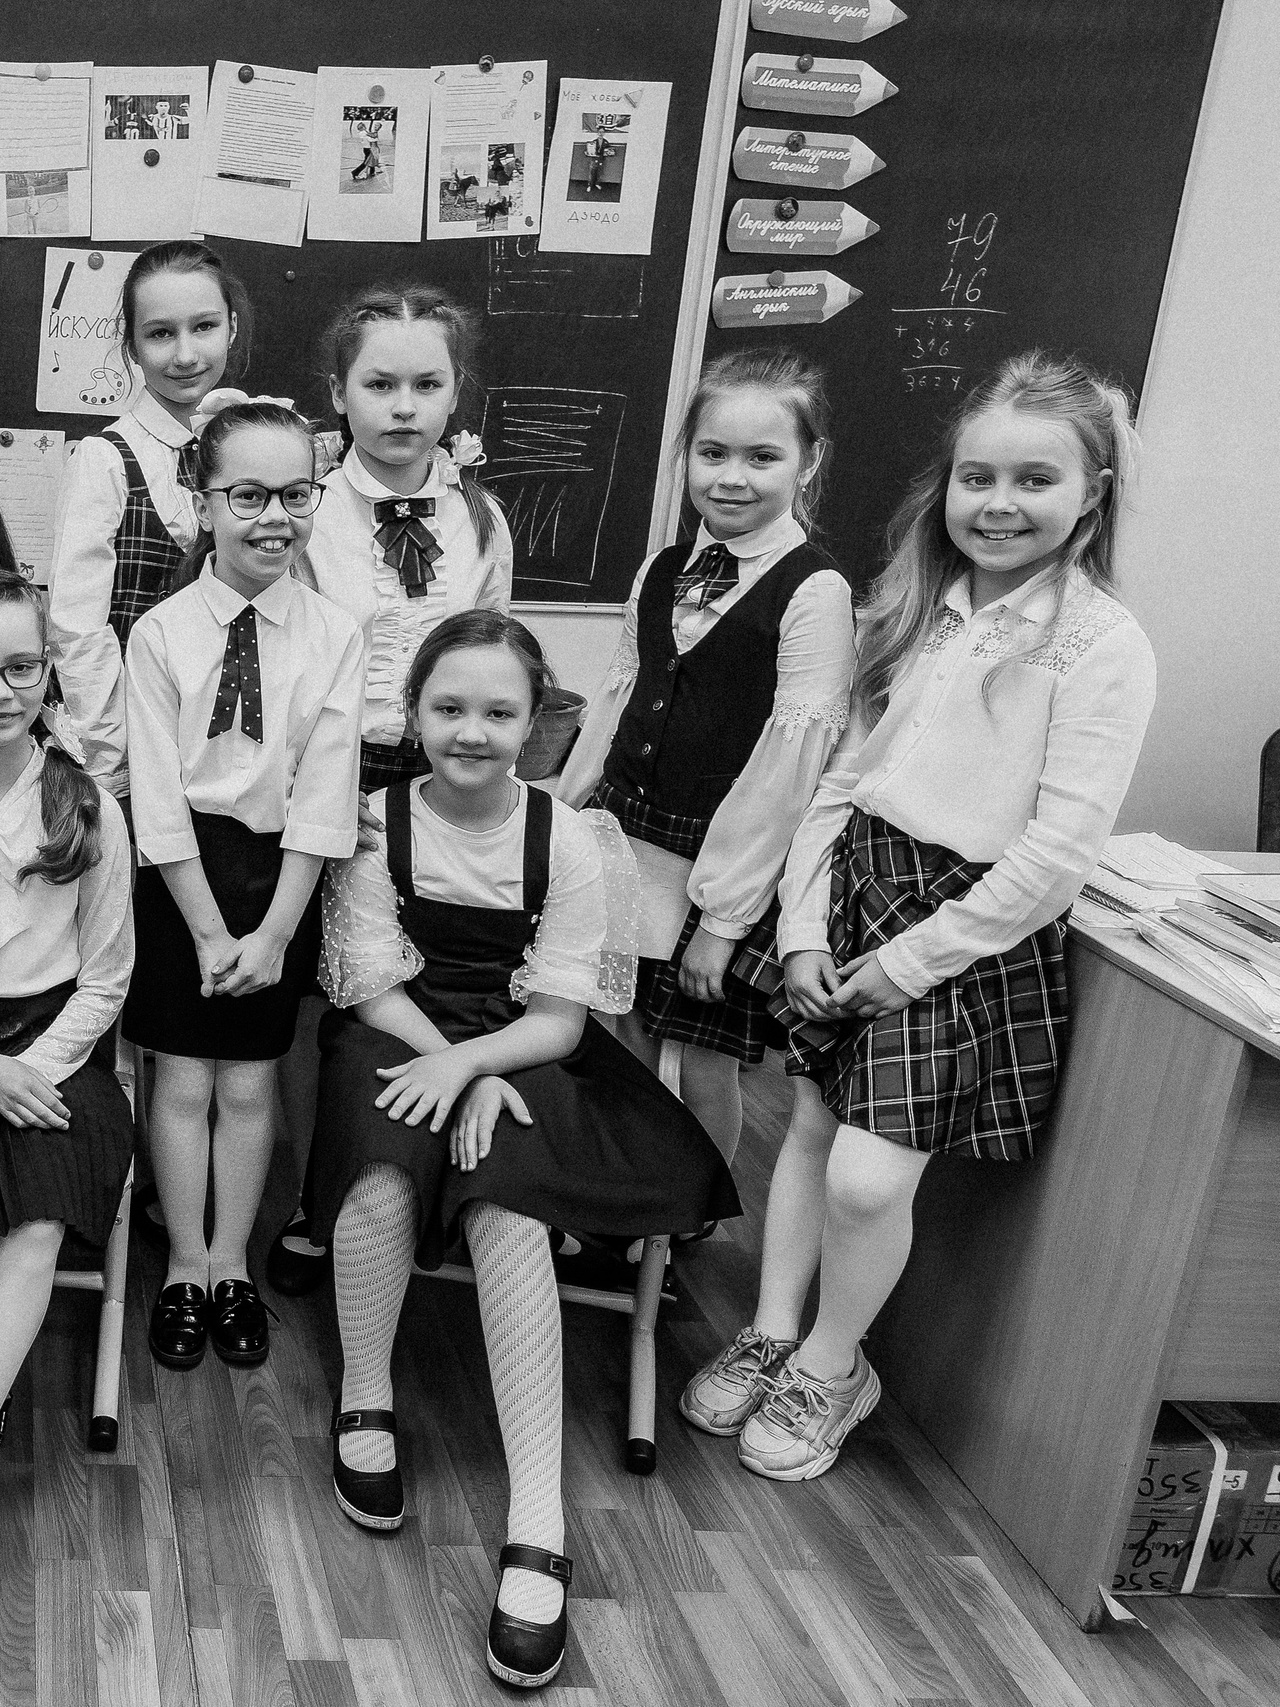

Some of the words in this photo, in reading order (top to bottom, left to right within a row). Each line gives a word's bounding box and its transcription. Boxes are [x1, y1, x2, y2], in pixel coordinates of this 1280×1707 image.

[827, 5, 870, 23] язык
[752, 70, 862, 93] Математика
[769, 160, 820, 174] чтение
[567, 210, 621, 224] ДЗЮДО
[737, 212, 844, 236] Окружающий
[770, 232, 806, 249] мир
[947, 212, 998, 263] 79
[726, 283, 819, 301] Английский
[940, 268, 987, 305] 46
[752, 302, 790, 319] язык
[911, 337, 950, 358] 316
